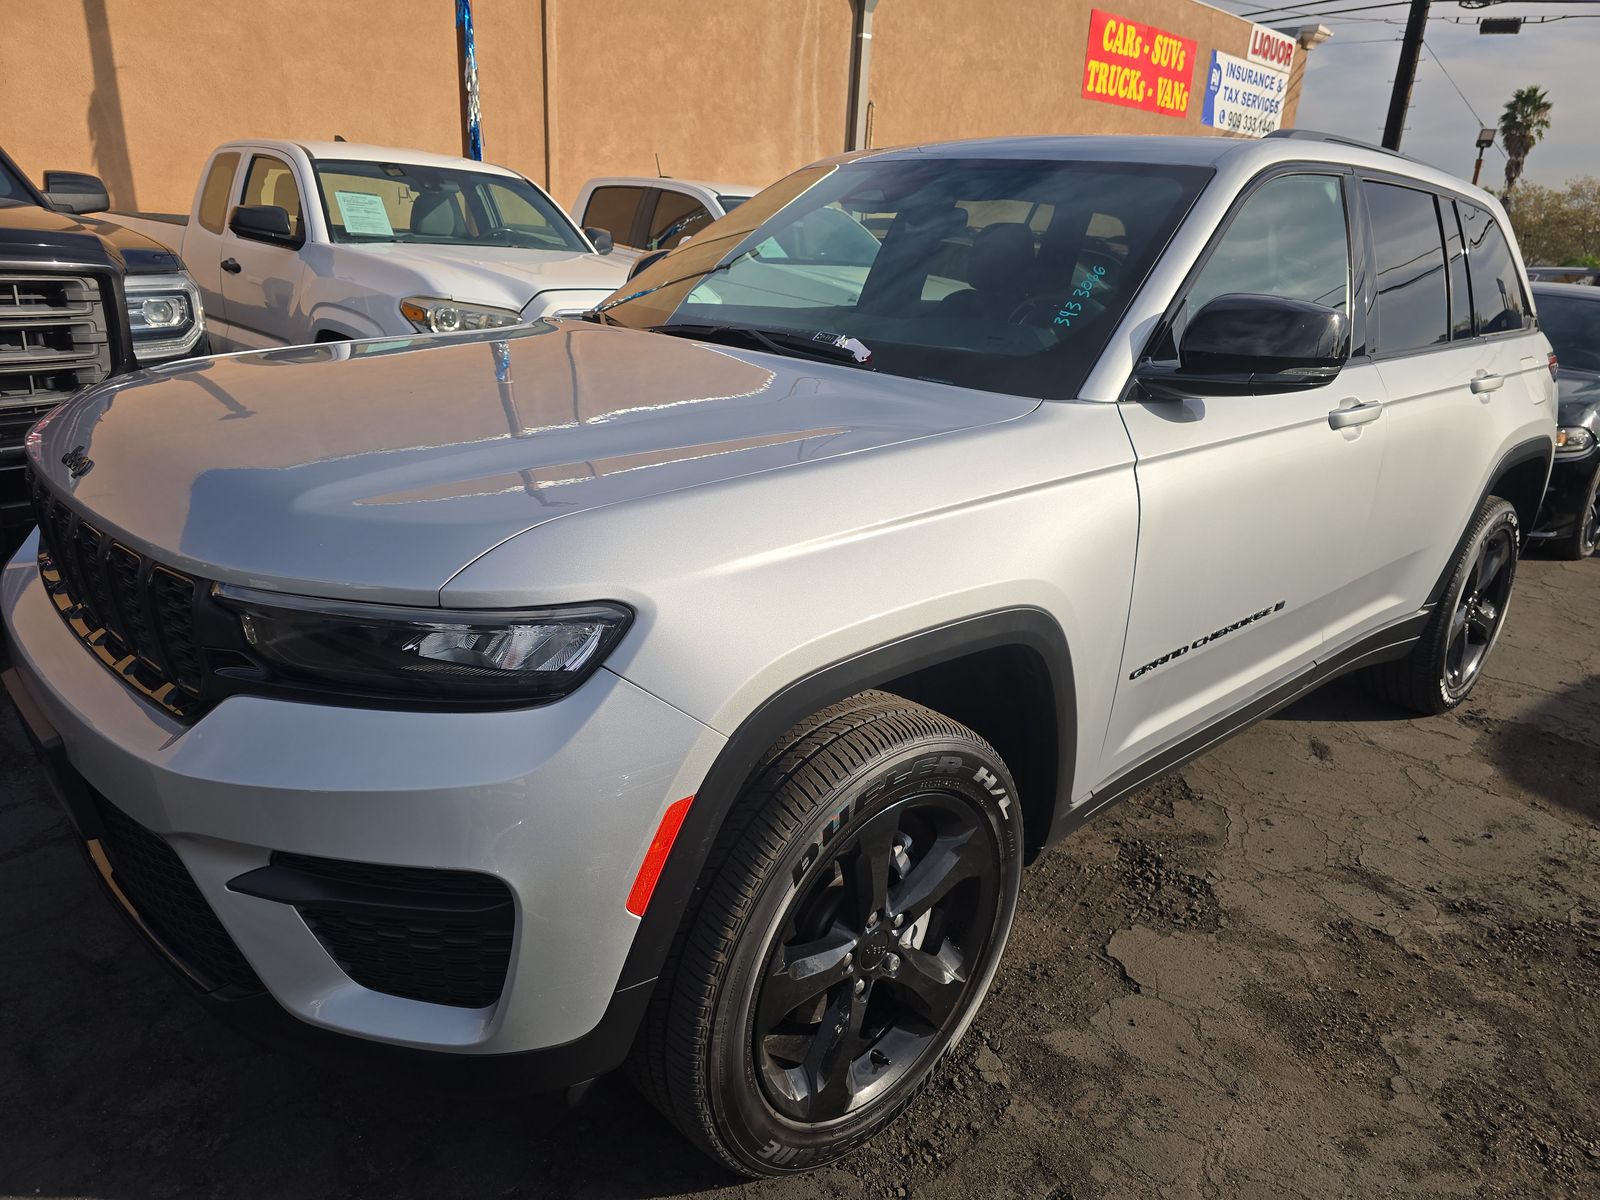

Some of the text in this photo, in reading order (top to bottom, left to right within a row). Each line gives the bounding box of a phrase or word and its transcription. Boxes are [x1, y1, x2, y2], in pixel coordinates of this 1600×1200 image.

[1251, 30, 1293, 67] LIQUOR
[1226, 62, 1276, 91] INSURANCE
[1276, 79, 1283, 93] &
[1223, 86, 1280, 114] TAX SERVICES
[1227, 111, 1242, 129] 909
[1242, 115, 1257, 133] 333
[1128, 605, 1274, 681] GRAND CHEROKEE
[972, 766, 1012, 820] H/L
